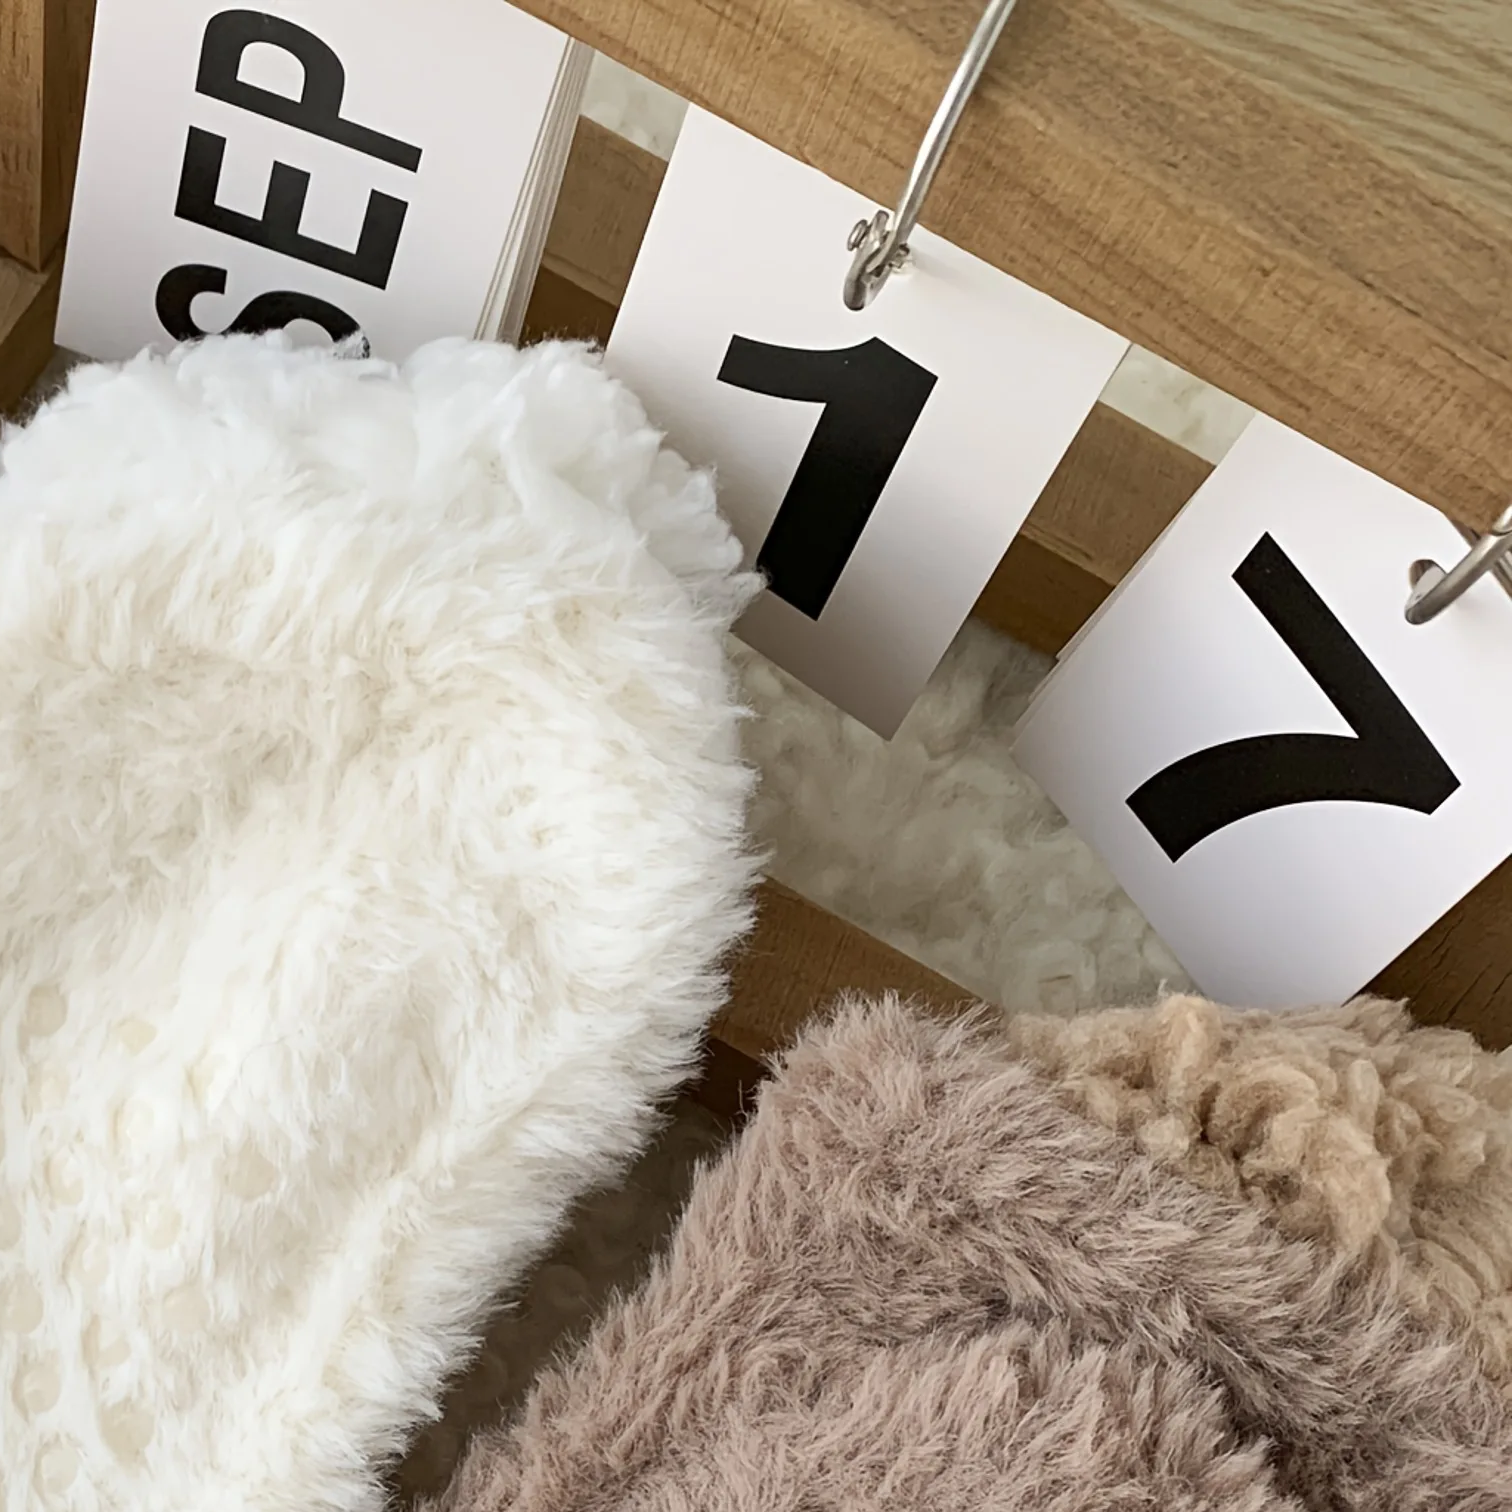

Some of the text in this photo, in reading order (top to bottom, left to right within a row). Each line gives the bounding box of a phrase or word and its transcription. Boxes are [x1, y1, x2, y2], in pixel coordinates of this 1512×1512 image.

[155, 8, 423, 358] SEP
[716, 335, 939, 622] 1
[1125, 531, 1461, 863] 7
